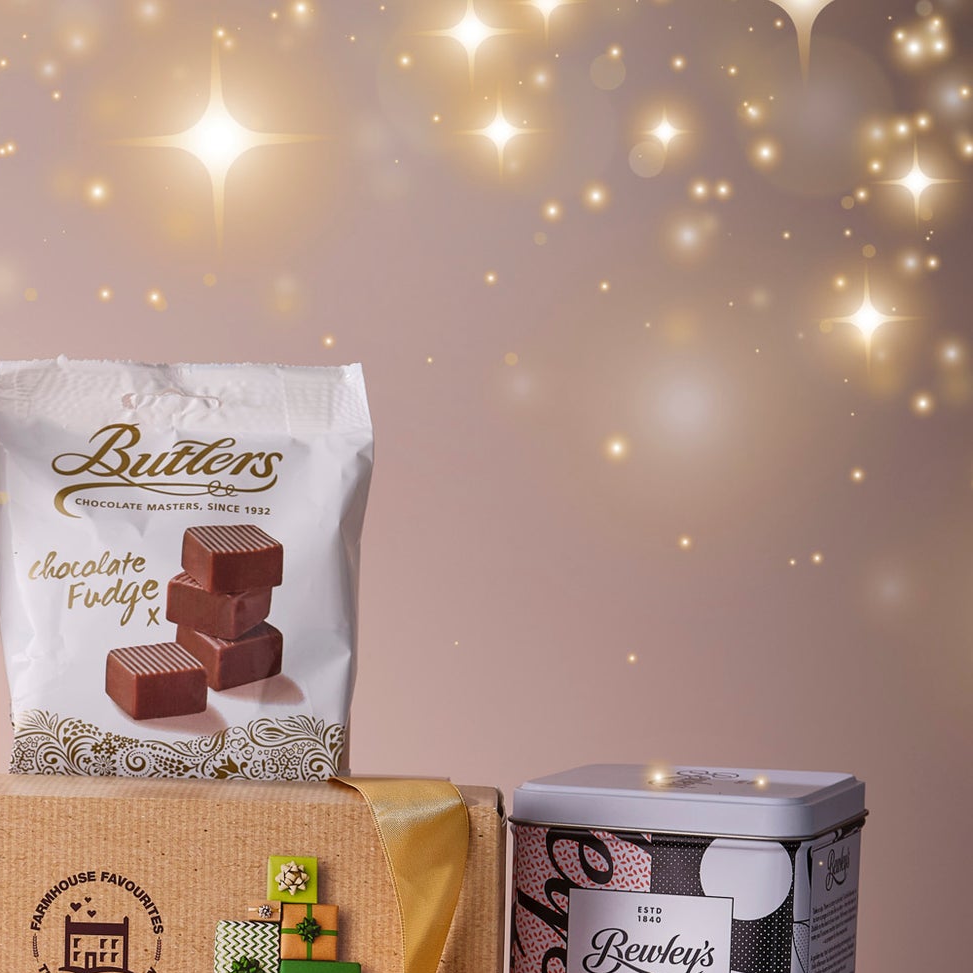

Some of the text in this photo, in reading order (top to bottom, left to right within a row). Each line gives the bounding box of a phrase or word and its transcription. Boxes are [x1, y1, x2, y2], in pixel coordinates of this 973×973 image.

[51, 423, 283, 497] Butlers
[75, 498, 272, 515] CHOCOLATE MASTERS, SINCE 1932
[28, 551, 146, 581] chocolate
[67, 577, 160, 627] Fudge
[30, 871, 164, 934] FARMHOUSE FAVOURITES
[637, 906, 662, 915] ESTD
[637, 915, 662, 924] 1840
